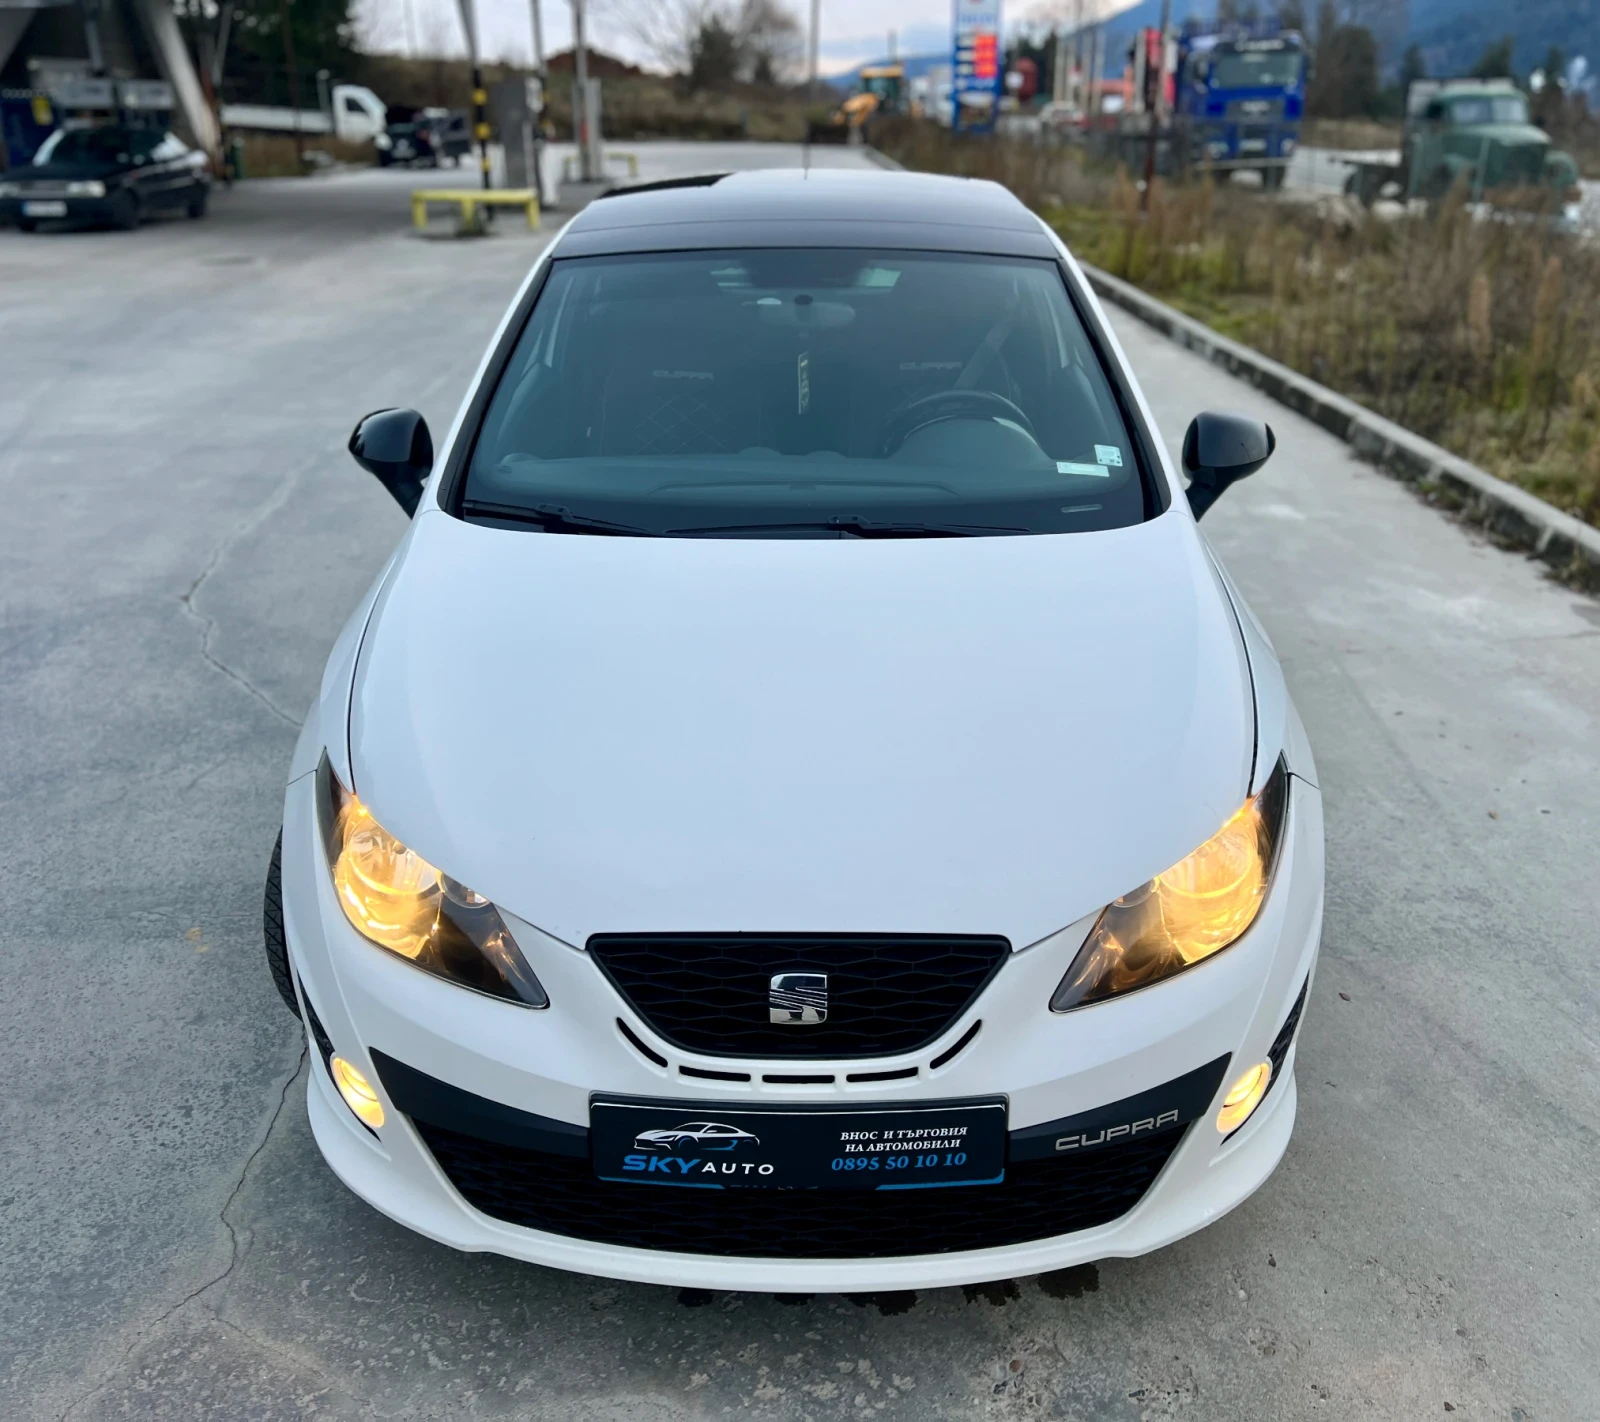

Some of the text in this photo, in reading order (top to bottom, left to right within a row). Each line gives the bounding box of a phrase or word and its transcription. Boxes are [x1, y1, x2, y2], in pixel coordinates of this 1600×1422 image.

[840, 1126, 968, 1141] ВНОС И ТЪРГОВИЯ
[1055, 1109, 1179, 1151] CUPRA
[845, 1139, 961, 1153] НА АВТОМОБИЛИ
[622, 1154, 775, 1175] SKY AUTO
[831, 1152, 967, 1171] 0895 50 10 10
